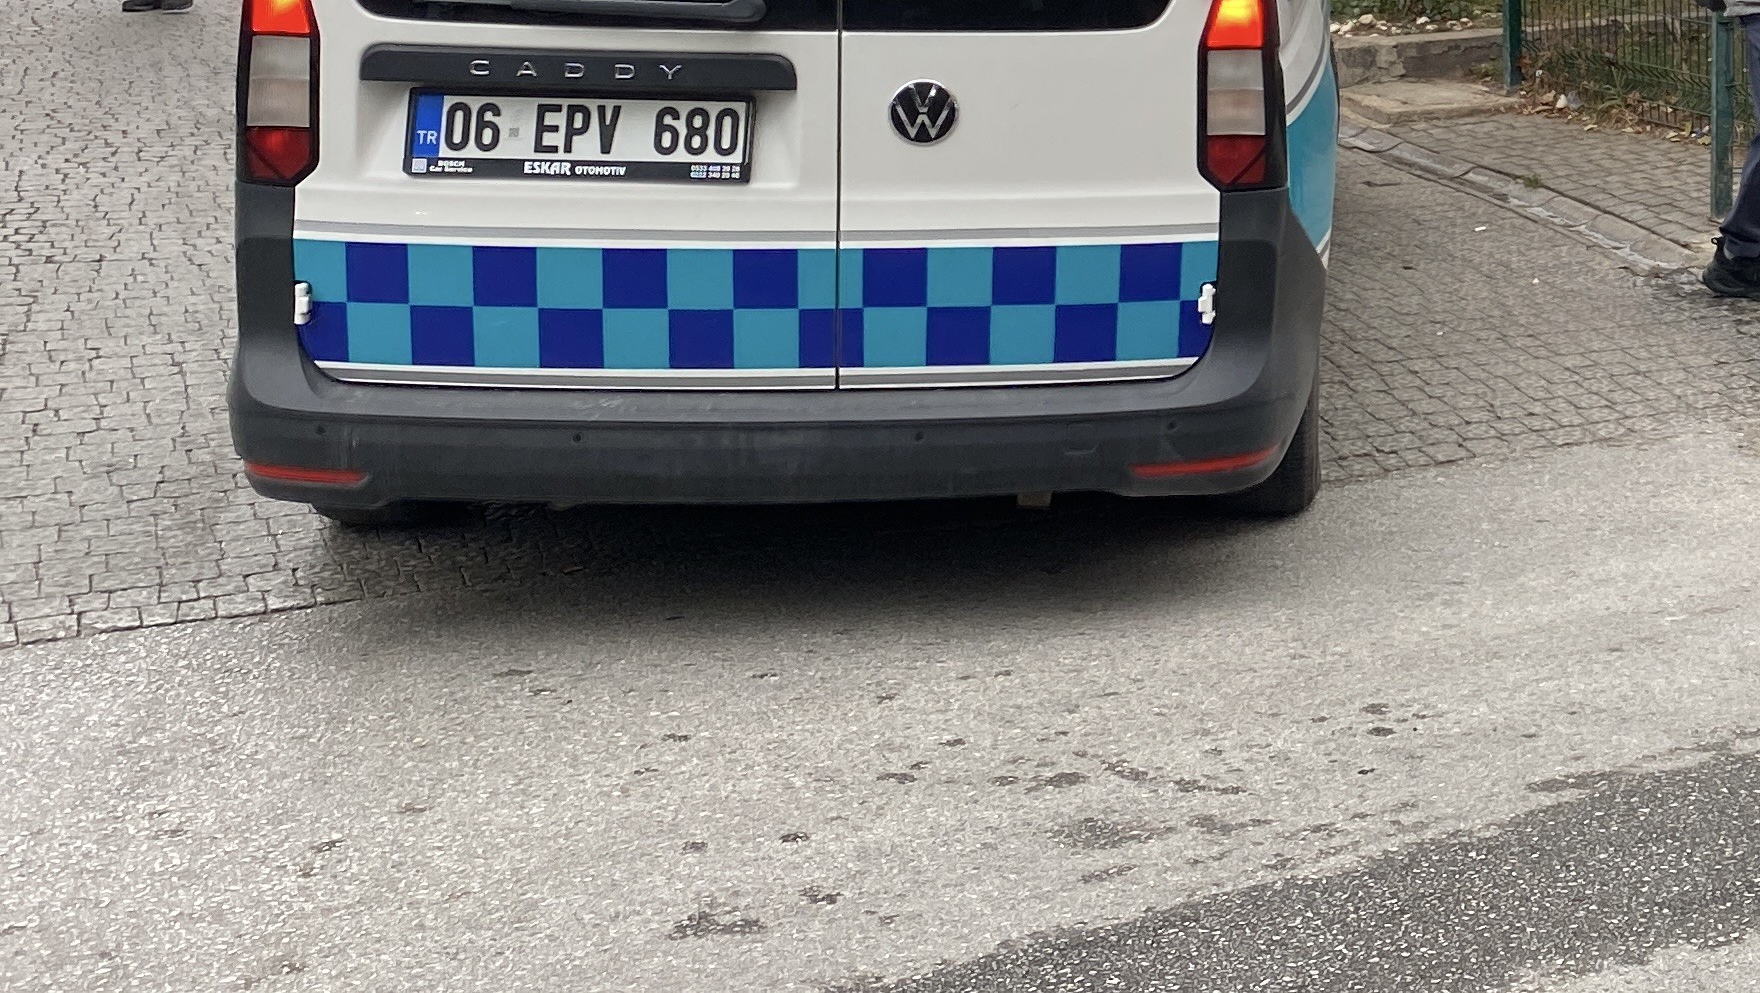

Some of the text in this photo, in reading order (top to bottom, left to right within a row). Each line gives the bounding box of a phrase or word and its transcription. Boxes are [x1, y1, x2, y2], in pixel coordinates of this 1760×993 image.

[469, 59, 683, 81] CADDY
[416, 130, 438, 145] TR
[444, 101, 742, 157] 06 EPV 680
[524, 161, 572, 176] ESKAR
